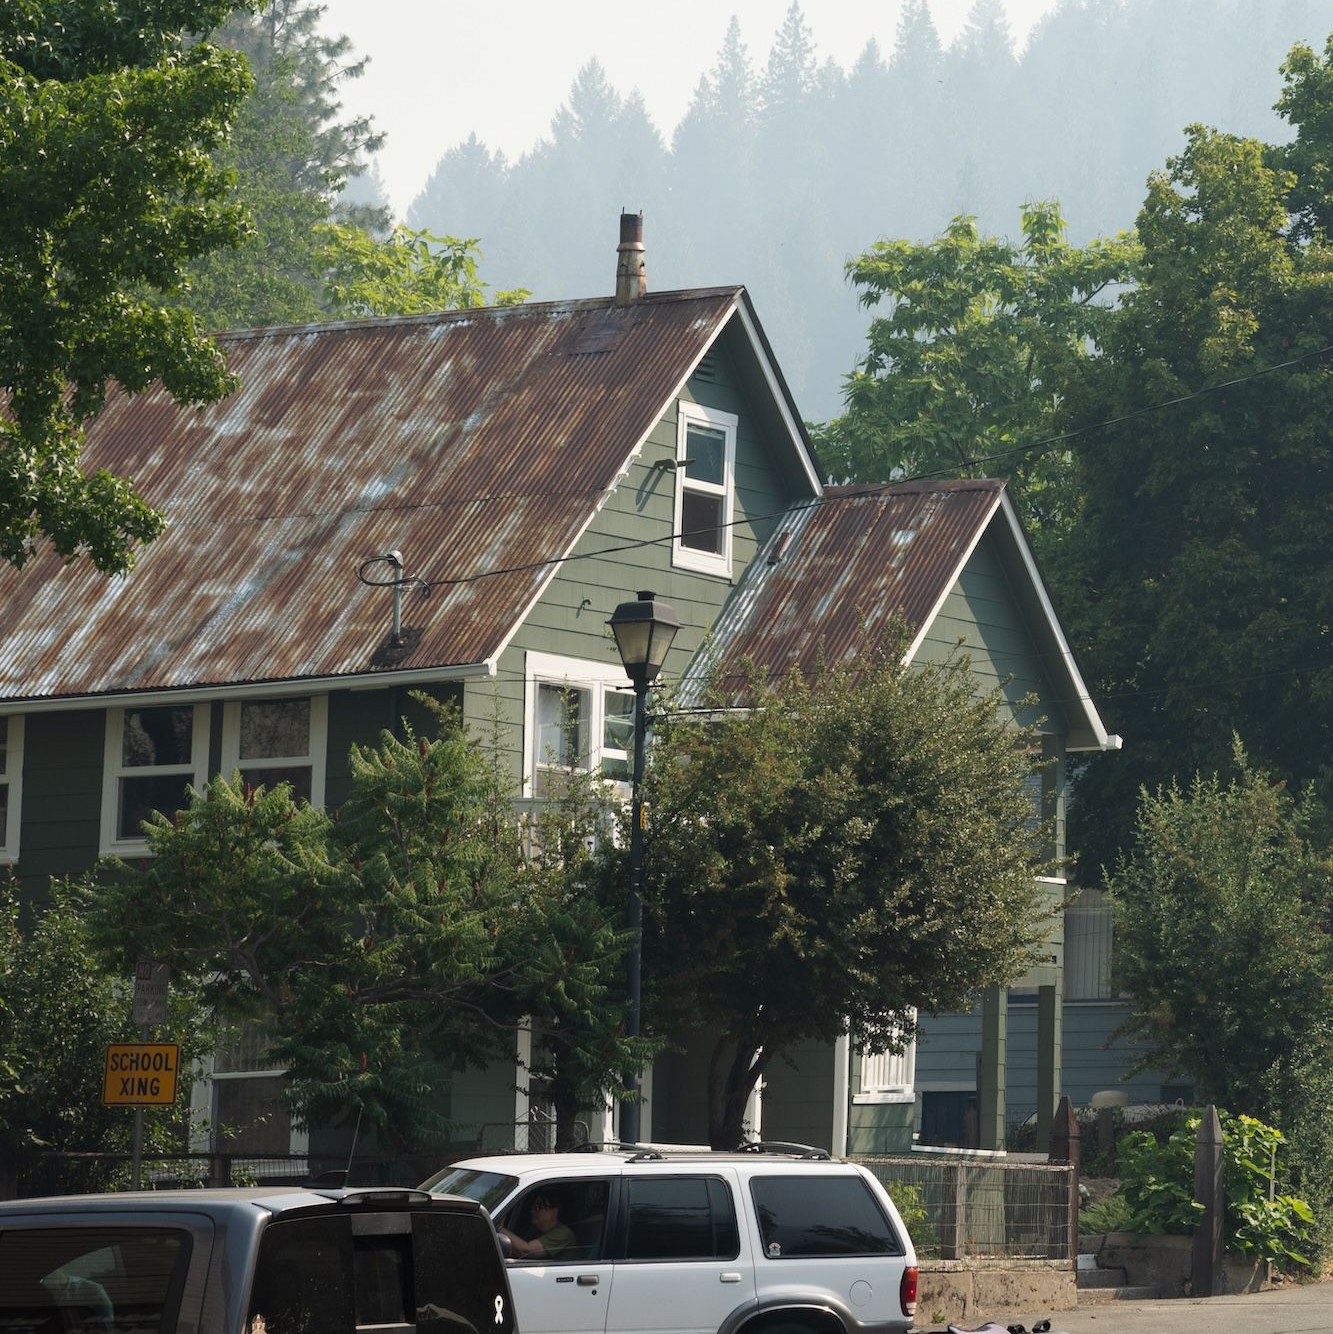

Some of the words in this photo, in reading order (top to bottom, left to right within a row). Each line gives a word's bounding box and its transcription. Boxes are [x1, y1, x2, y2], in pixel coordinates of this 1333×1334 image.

[137, 962, 151, 979] NO
[110, 1051, 174, 1072] SCHOOL
[119, 1077, 160, 1096] XING
